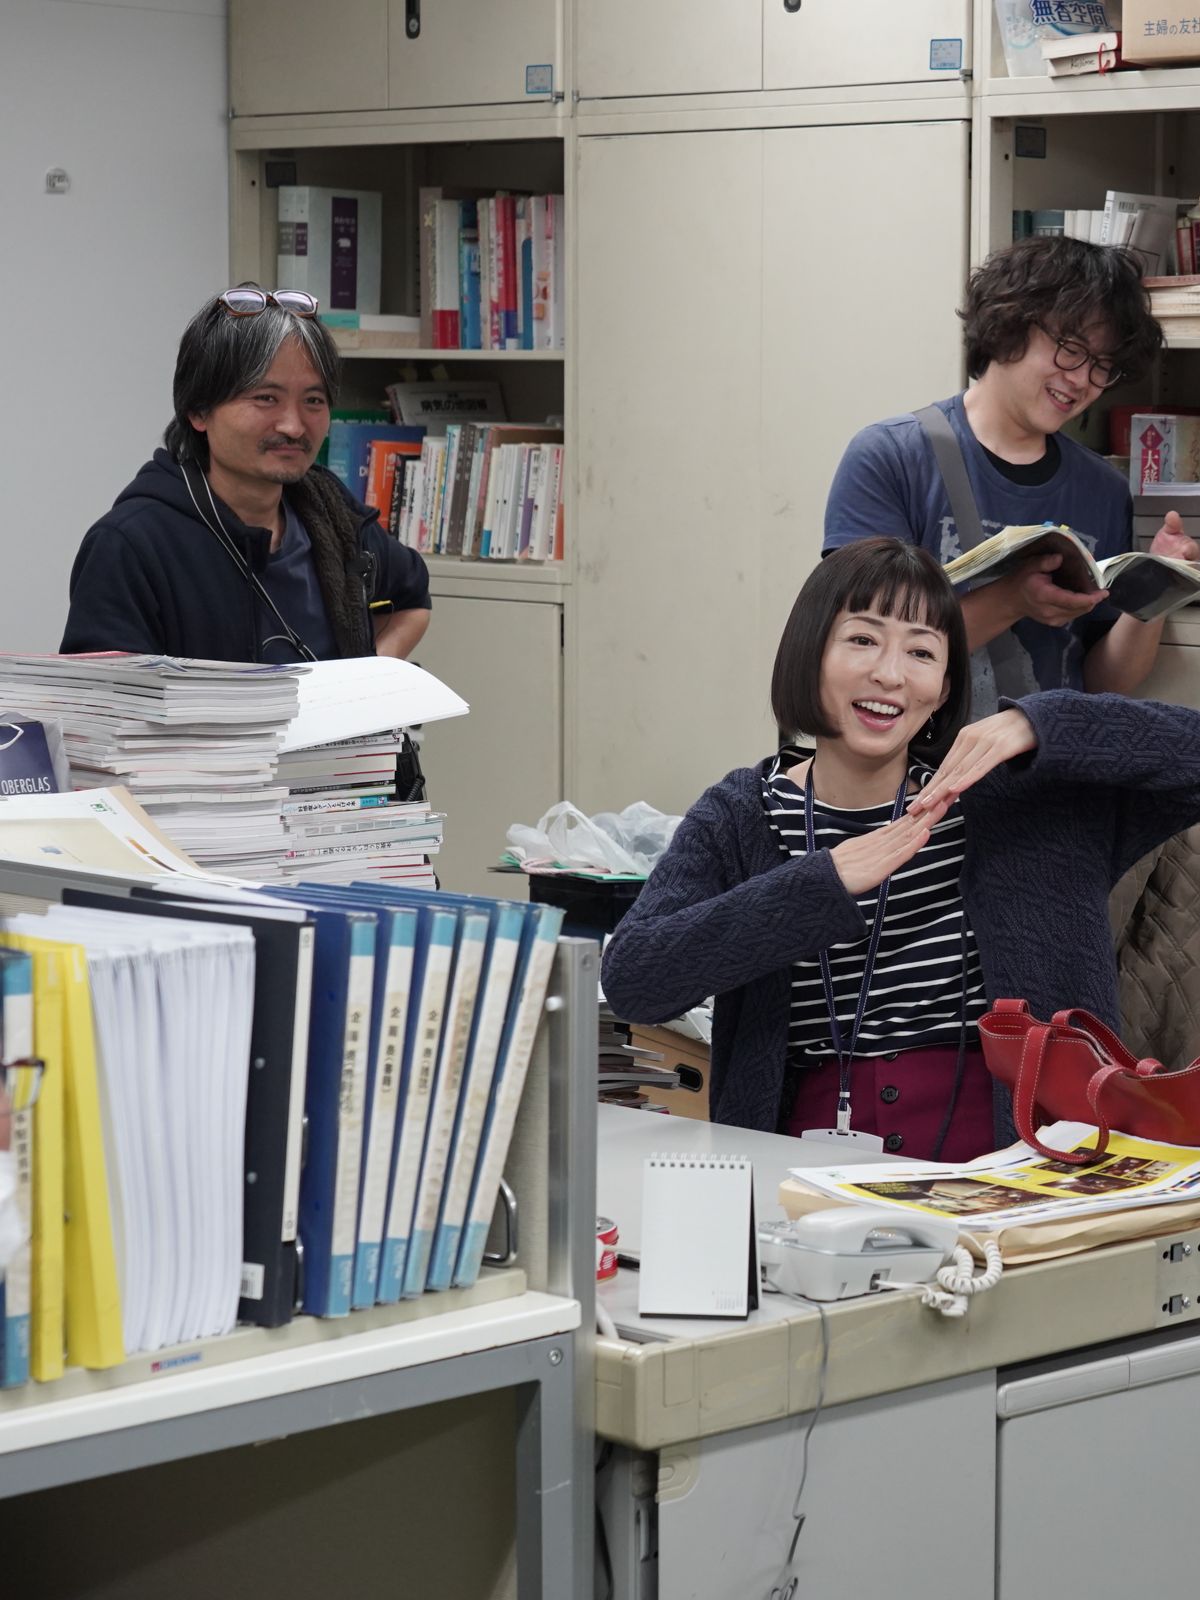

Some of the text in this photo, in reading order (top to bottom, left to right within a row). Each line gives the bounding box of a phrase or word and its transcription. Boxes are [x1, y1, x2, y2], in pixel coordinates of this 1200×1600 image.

[1033, 0, 1107, 26] 無香空間
[1, 777, 50, 795] OBERGLAS
